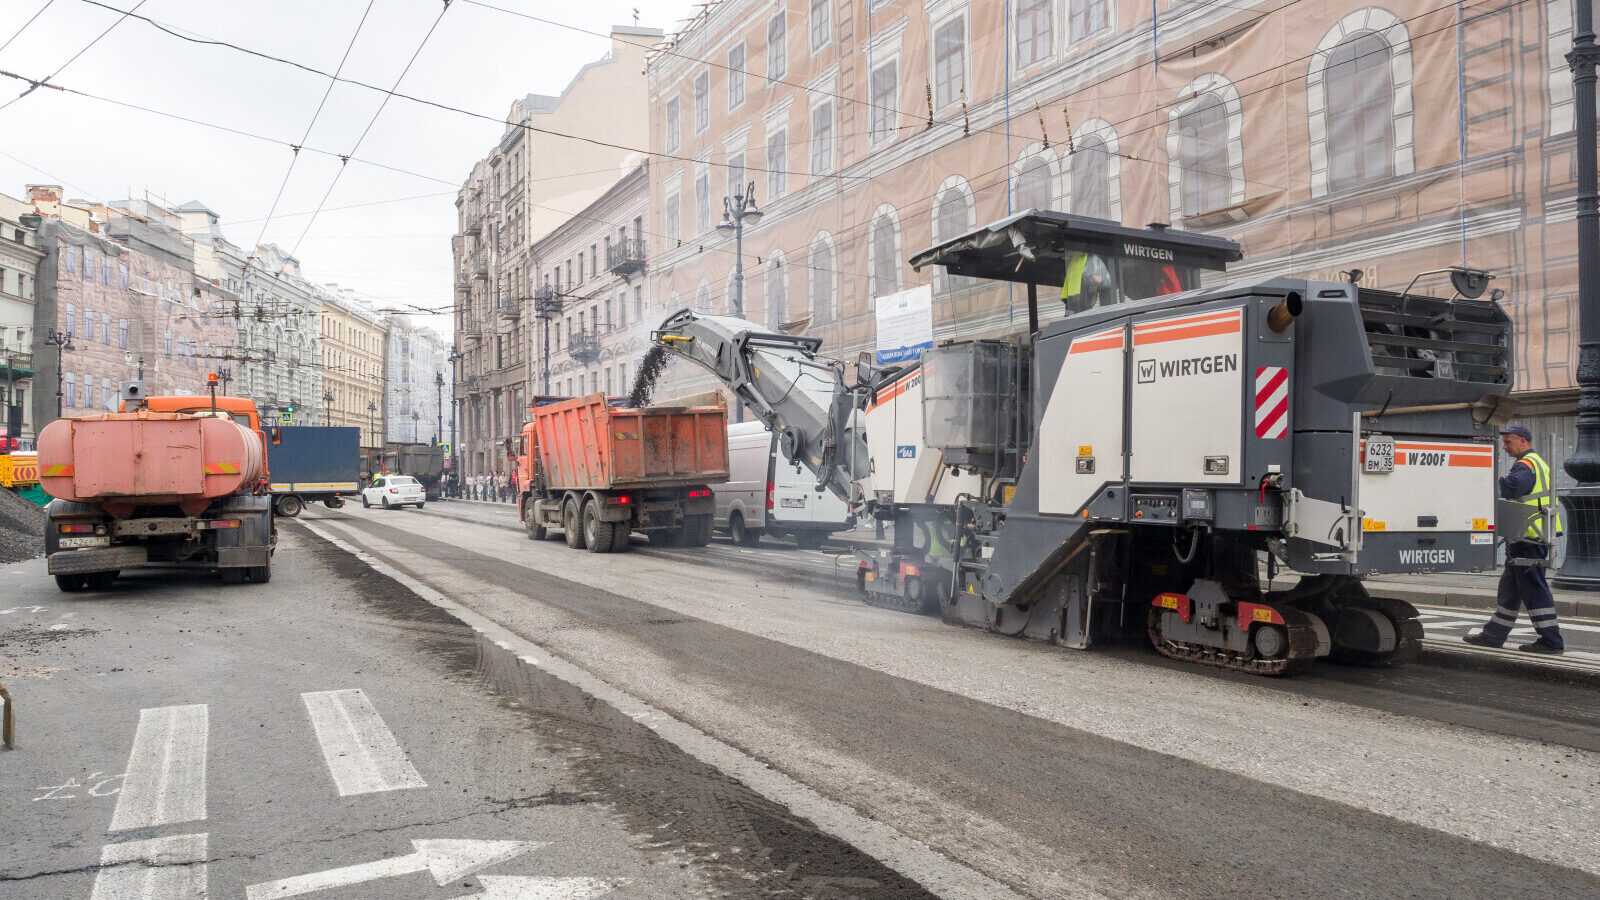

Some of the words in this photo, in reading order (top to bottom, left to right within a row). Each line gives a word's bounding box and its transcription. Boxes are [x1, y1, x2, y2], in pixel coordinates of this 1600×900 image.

[1123, 243, 1173, 260] WIRTGEN
[1160, 353, 1237, 378] WIRTGEN
[1370, 443, 1392, 456] 6232
[1383, 457, 1393, 467] 35
[1408, 452, 1419, 466] W
[1399, 549, 1455, 564] WIRTGEN
